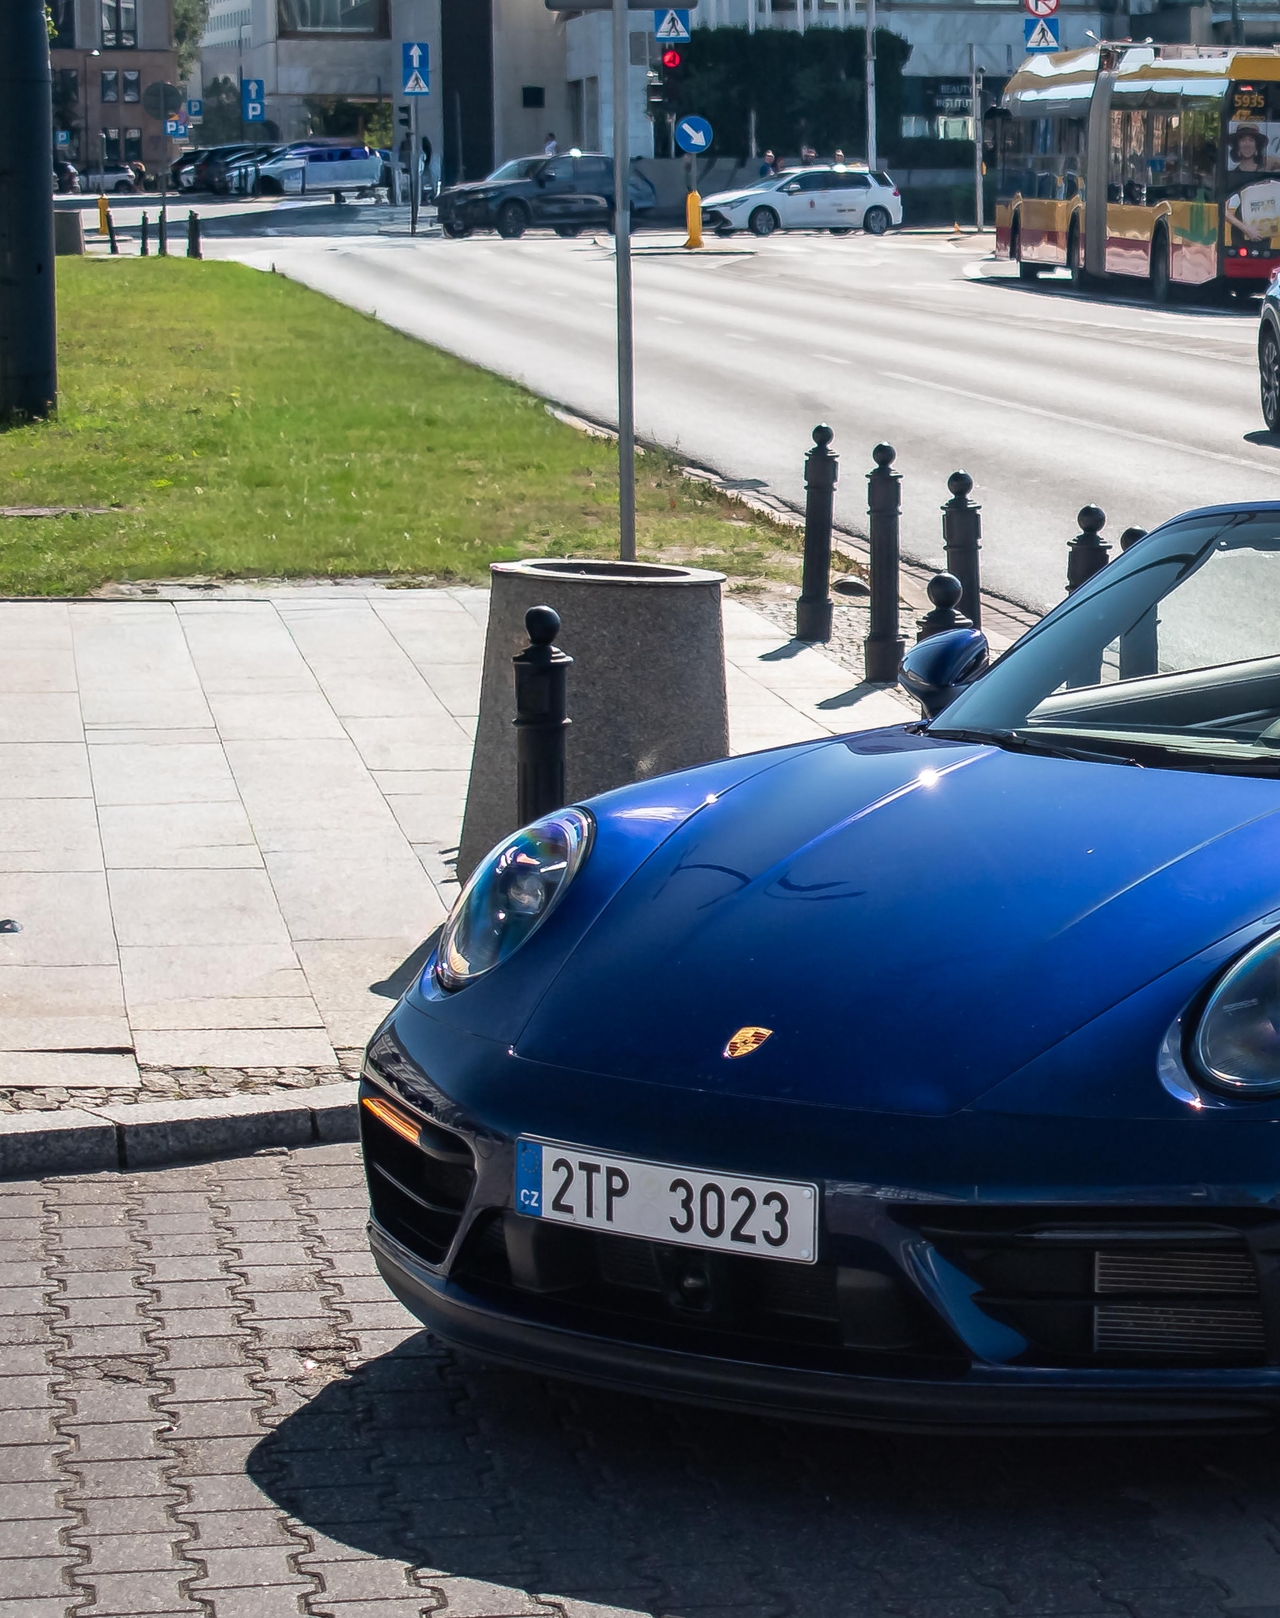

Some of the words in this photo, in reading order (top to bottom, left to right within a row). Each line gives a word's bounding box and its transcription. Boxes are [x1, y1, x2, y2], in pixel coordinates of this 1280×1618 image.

[941, 85, 973, 94] BEAUTY
[1234, 95, 1265, 107] 5935
[249, 103, 261, 120] P
[520, 1189, 539, 1207] CZ
[551, 1157, 630, 1222] 2TP
[669, 1178, 790, 1247] 3023
